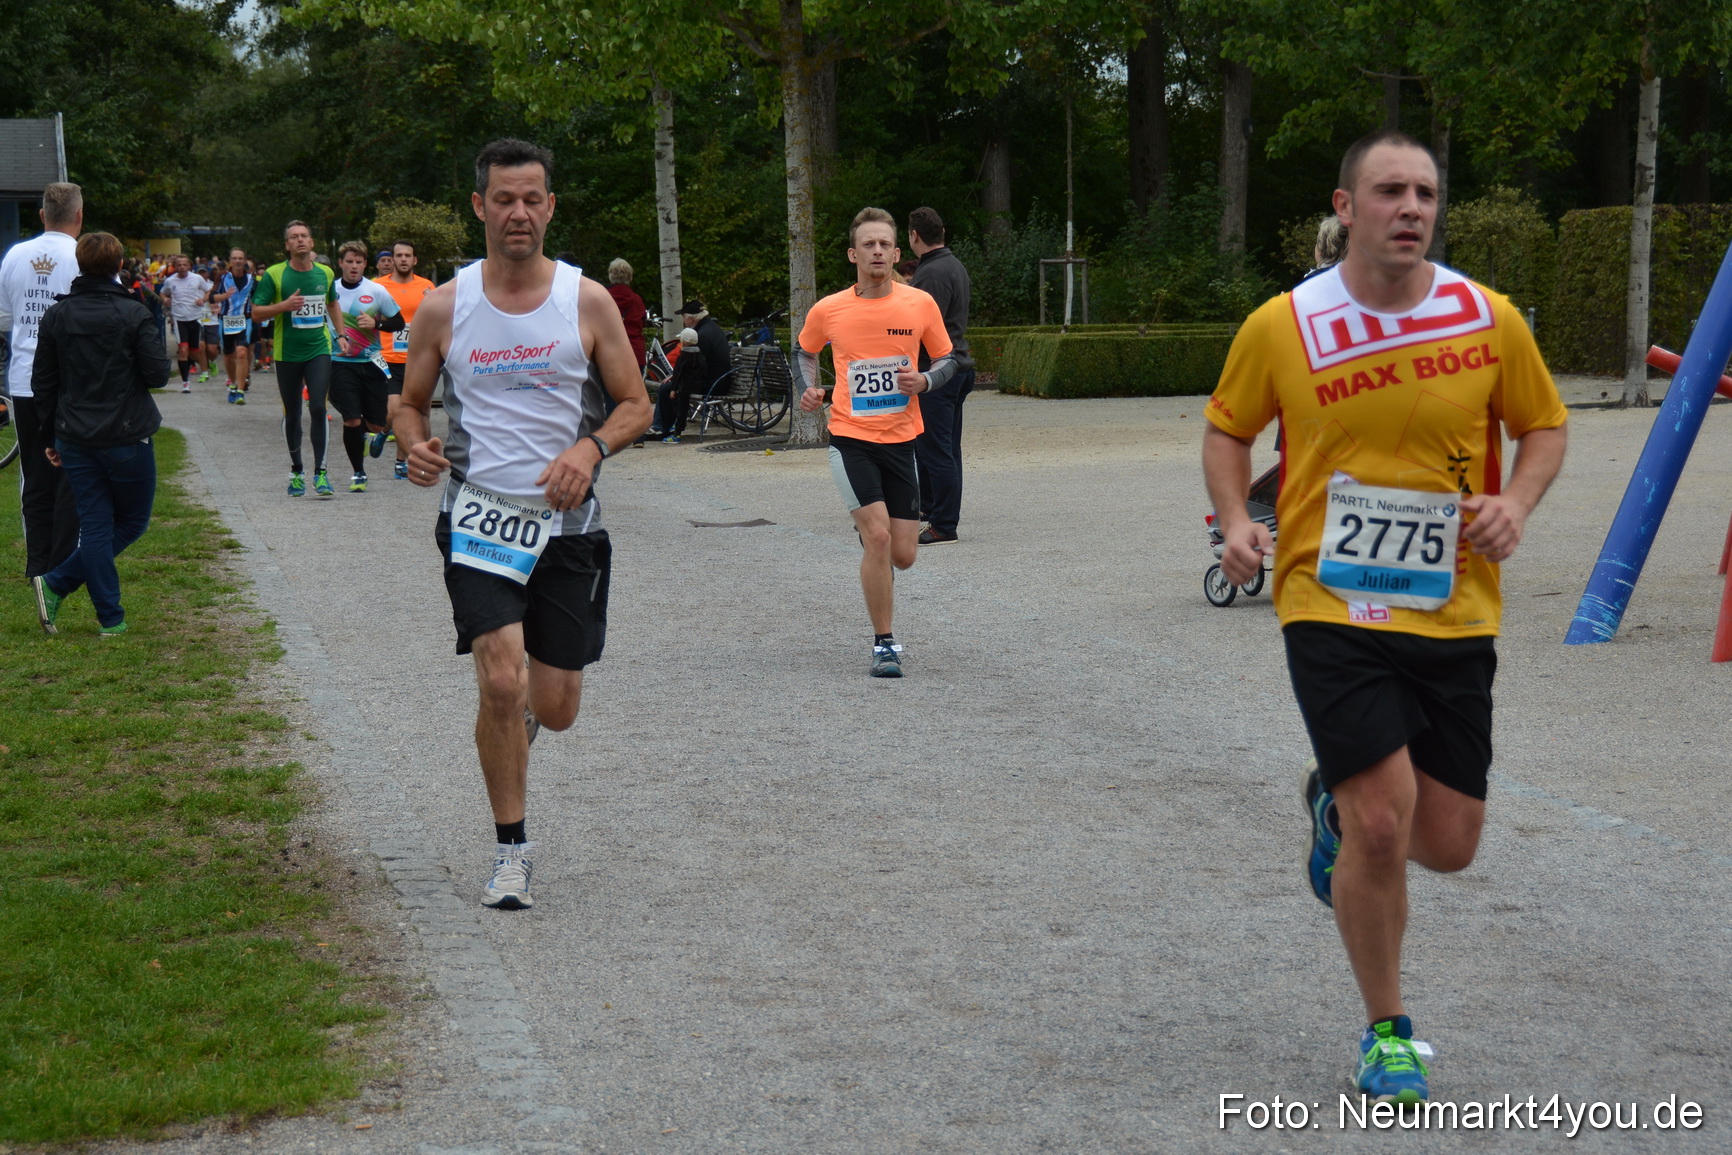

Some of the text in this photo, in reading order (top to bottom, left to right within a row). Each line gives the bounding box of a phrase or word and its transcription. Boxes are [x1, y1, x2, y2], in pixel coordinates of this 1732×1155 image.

[37, 275, 48, 285] IM
[24, 288, 55, 300] UFTRA
[25, 302, 51, 312] SEIN
[27, 329, 38, 338] JE
[396, 329, 409, 341] 27
[887, 328, 913, 336] THULE
[473, 361, 550, 375] Pure Performance
[870, 361, 899, 370] Neumarkt
[854, 370, 900, 394] 258
[1314, 343, 1499, 407] MAX BÖGL
[867, 397, 897, 408] Markus
[463, 485, 539, 517] PARTL Neumarkt
[1331, 493, 1437, 516] PARTL Neumarkt
[457, 501, 541, 549] 2800
[1335, 513, 1445, 565] 2775
[466, 540, 513, 564] Markus
[1357, 571, 1411, 590] Julian
